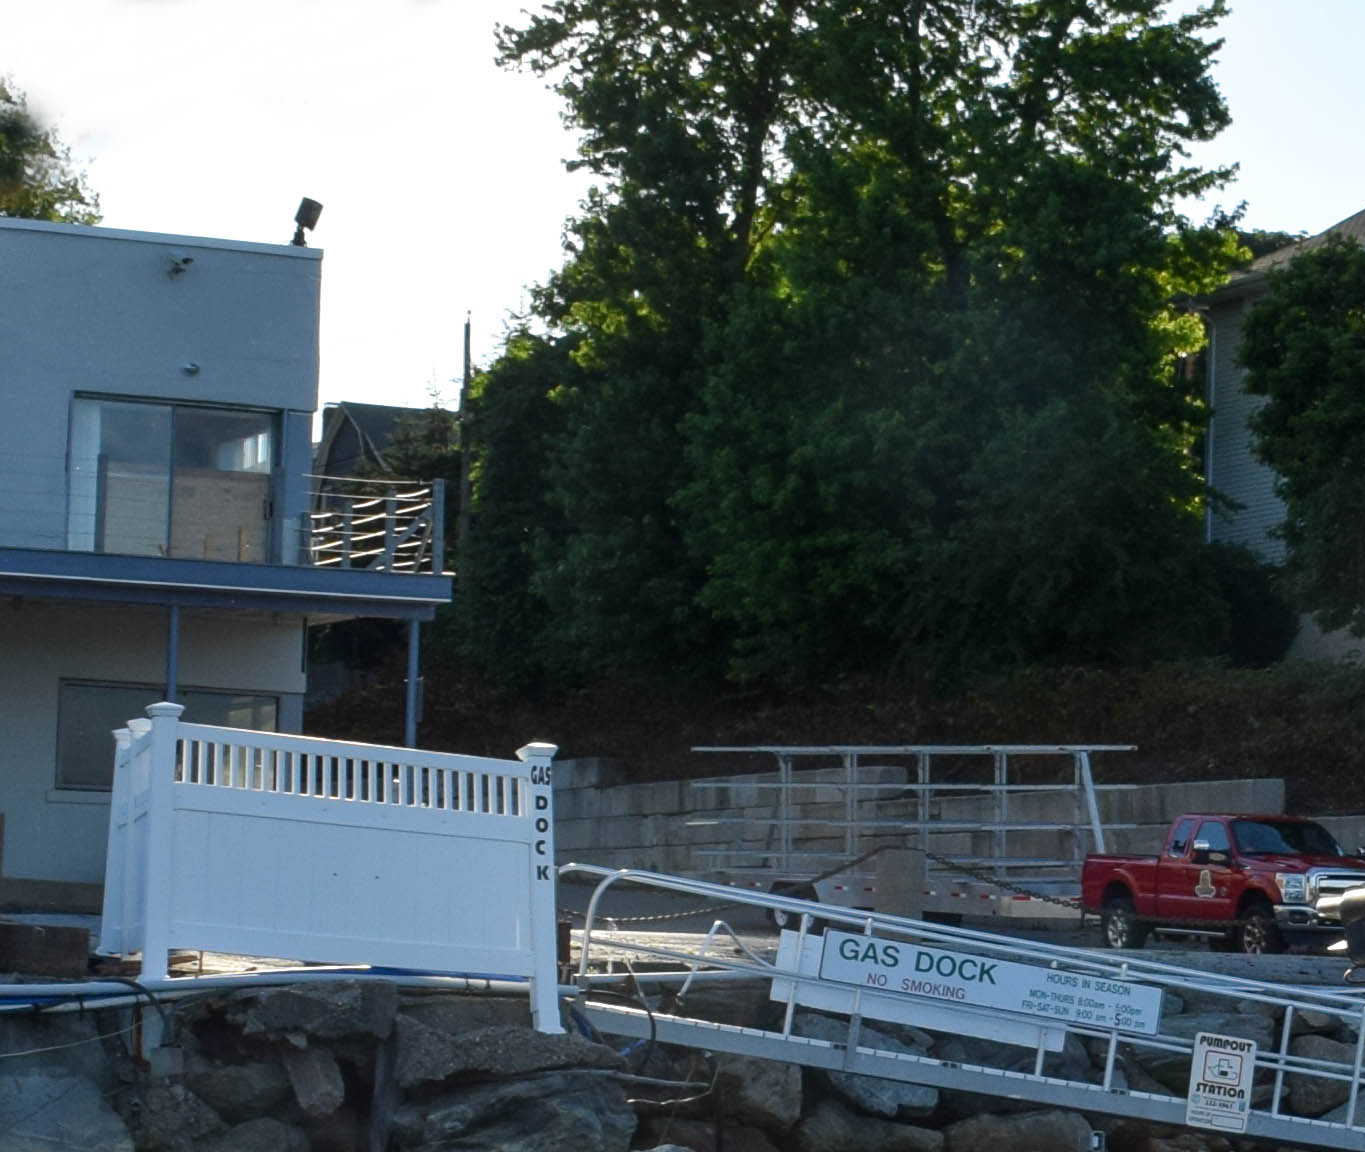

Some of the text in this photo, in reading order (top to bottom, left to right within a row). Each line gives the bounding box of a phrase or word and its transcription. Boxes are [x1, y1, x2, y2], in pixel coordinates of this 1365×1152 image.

[530, 765, 551, 785] GAS
[535, 795, 550, 880] DOCK
[839, 938, 998, 985] GAS DOCK
[866, 972, 966, 1000] NO SMOKING
[1046, 972, 1131, 996] HOURS IN SEASON
[1200, 1035, 1253, 1053] PUMPOUT
[1195, 1082, 1245, 1099] STATION
